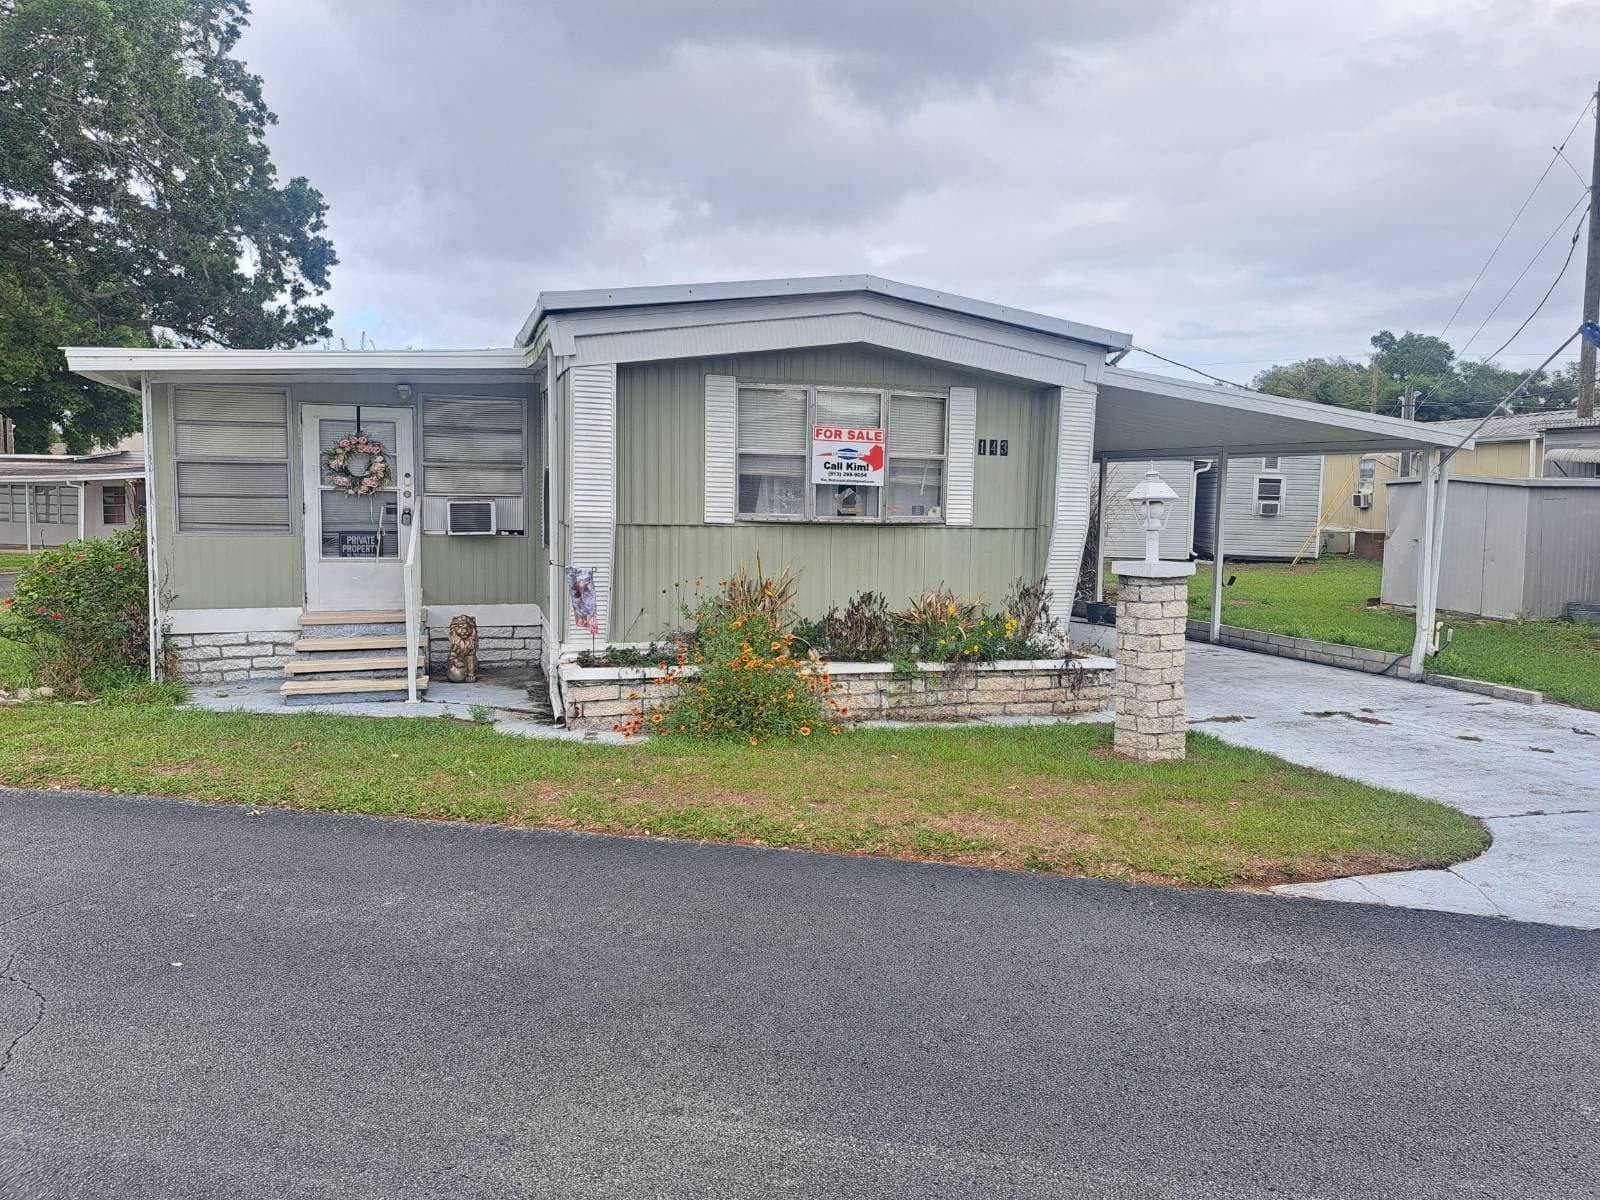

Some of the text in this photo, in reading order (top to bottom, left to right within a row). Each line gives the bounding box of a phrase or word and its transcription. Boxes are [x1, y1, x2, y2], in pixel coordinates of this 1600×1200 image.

[815, 428, 883, 441] FOR SALE
[979, 440, 1007, 456] 143
[823, 461, 869, 471] Call Kim!
[346, 536, 376, 545] PRIVATE
